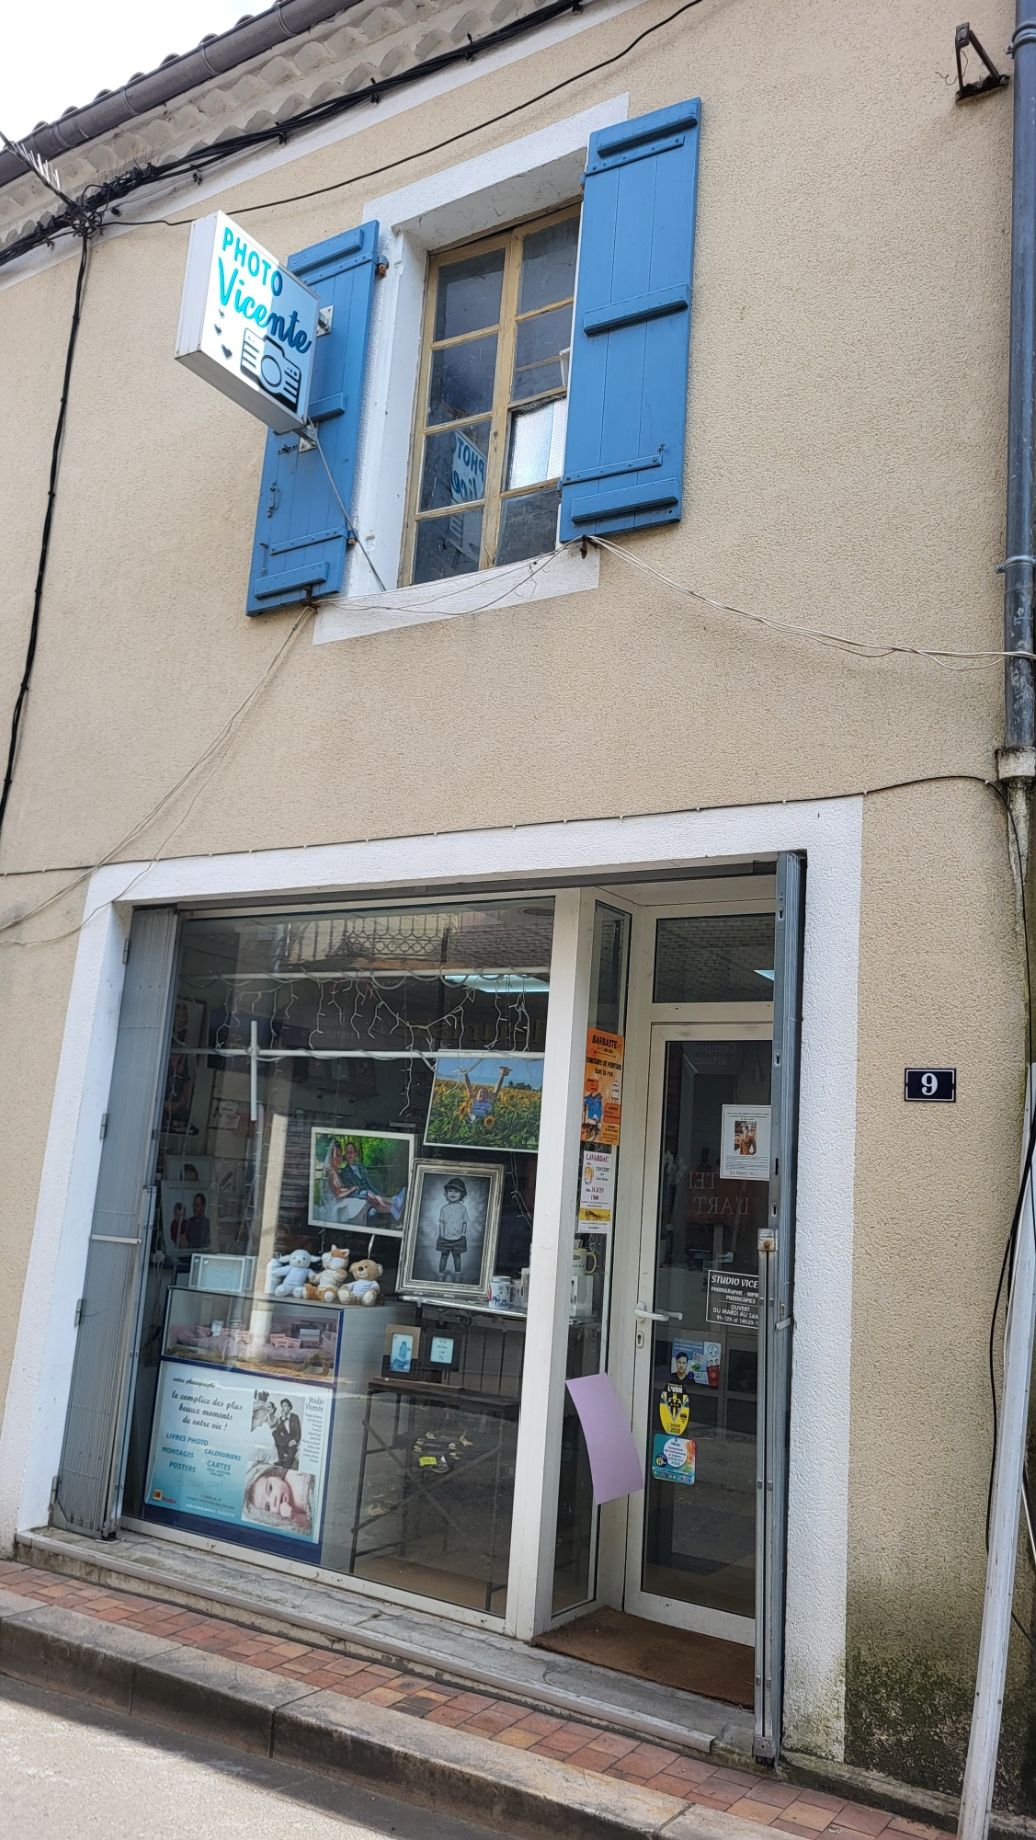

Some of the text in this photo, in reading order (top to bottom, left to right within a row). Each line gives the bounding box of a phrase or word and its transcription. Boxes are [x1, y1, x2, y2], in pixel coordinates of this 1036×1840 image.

[222, 226, 283, 297] PHOTO
[218, 255, 312, 354] Vicente
[592, 1034, 618, 1049] BARBASTE
[921, 1072, 938, 1096] 9
[586, 1153, 609, 1163] LAVARDAC
[711, 1274, 759, 1289] STUDIO VICE
[722, 1308, 738, 1316] MARDI
[730, 1304, 750, 1312] OUVERT
[180, 1393, 210, 1405] complice
[212, 1397, 224, 1407] des
[226, 1400, 243, 1411] plus
[179, 1402, 233, 1421] beaux moments
[182, 1415, 190, 1425] de
[192, 1418, 210, 1428] votre
[211, 1421, 222, 1431] vie
[165, 1432, 209, 1447] LIVRES PHOTO
[161, 1446, 195, 1459] MONTAGES
[204, 1448, 242, 1461] CALENDRIERS
[168, 1461, 196, 1473] POSTERS
[206, 1460, 231, 1471] CARTES
